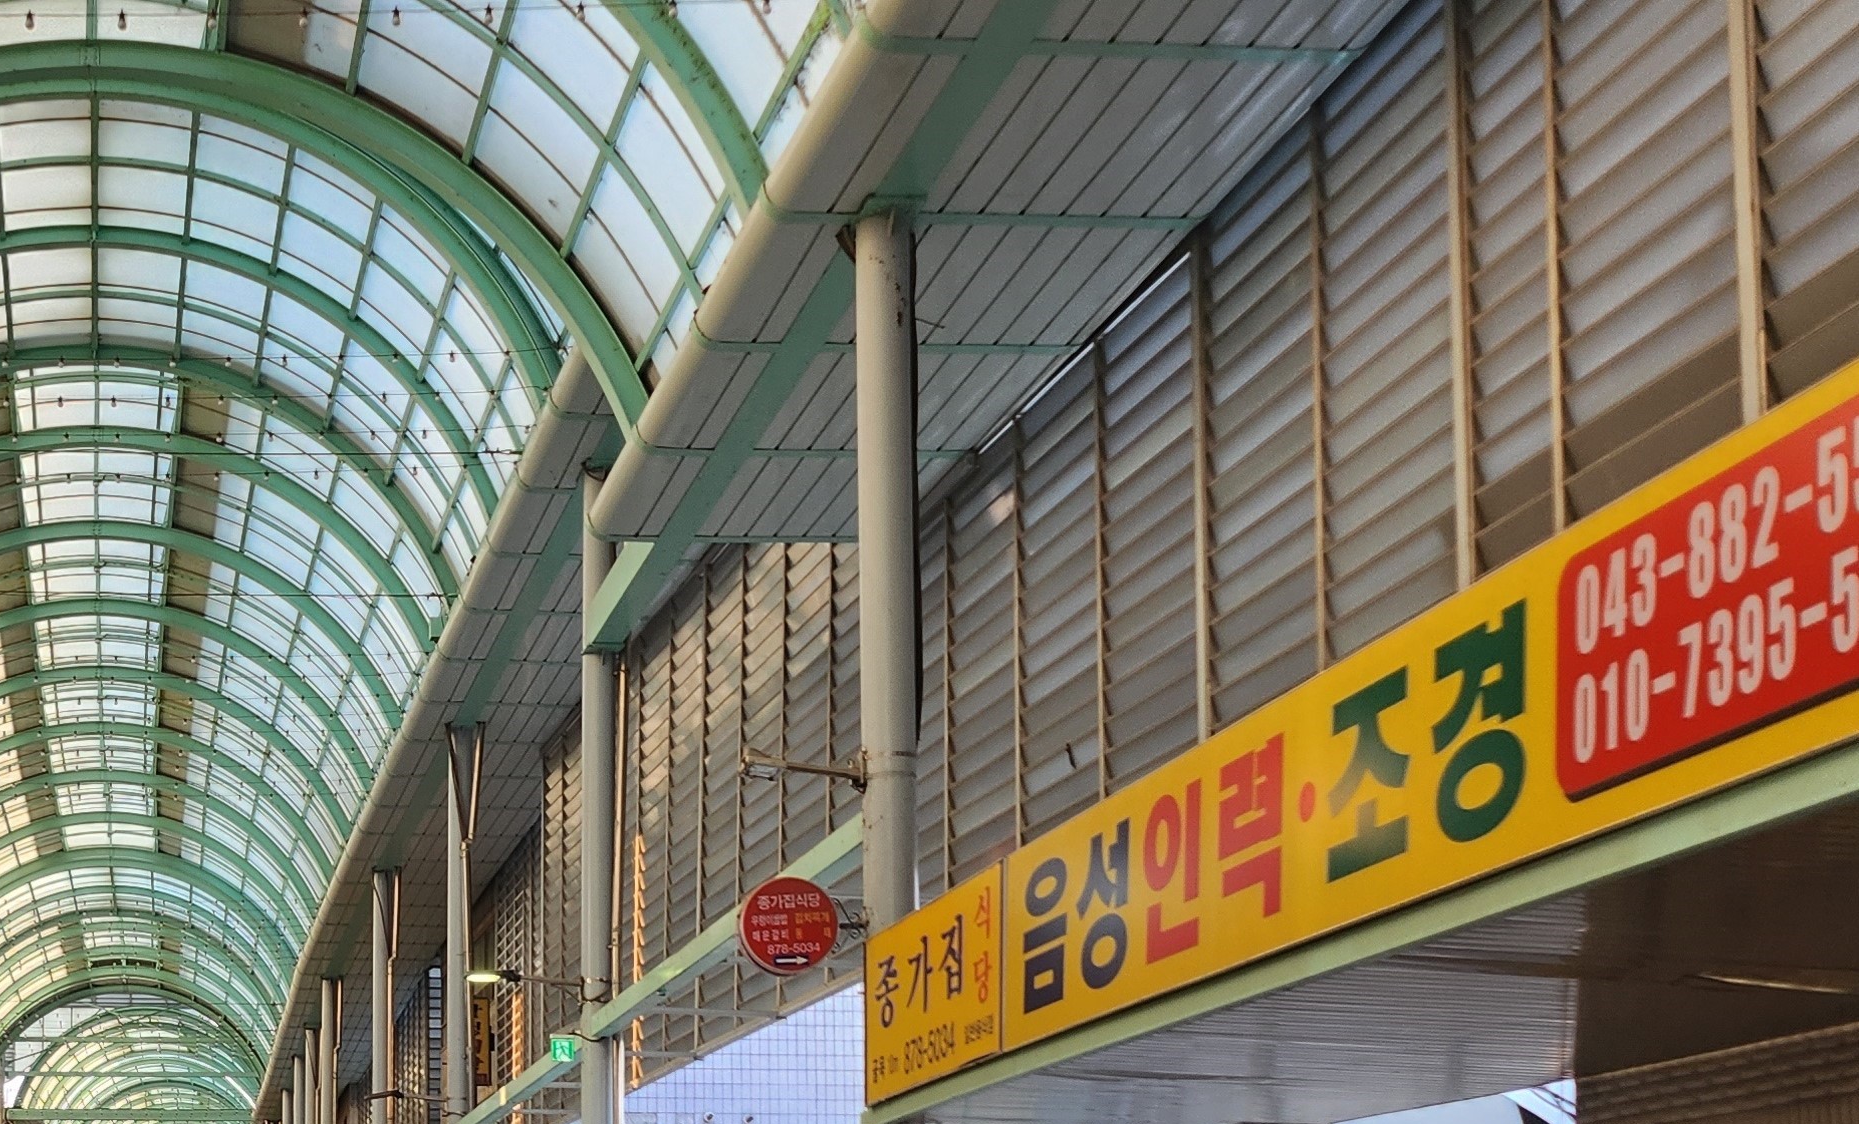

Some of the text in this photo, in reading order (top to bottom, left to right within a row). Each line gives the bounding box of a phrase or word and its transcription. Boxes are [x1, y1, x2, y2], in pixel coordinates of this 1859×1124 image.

[1575, 416, 1859, 655] 043-882-5
[767, 942, 821, 955] 878-5034
[874, 913, 964, 1028] 종가집
